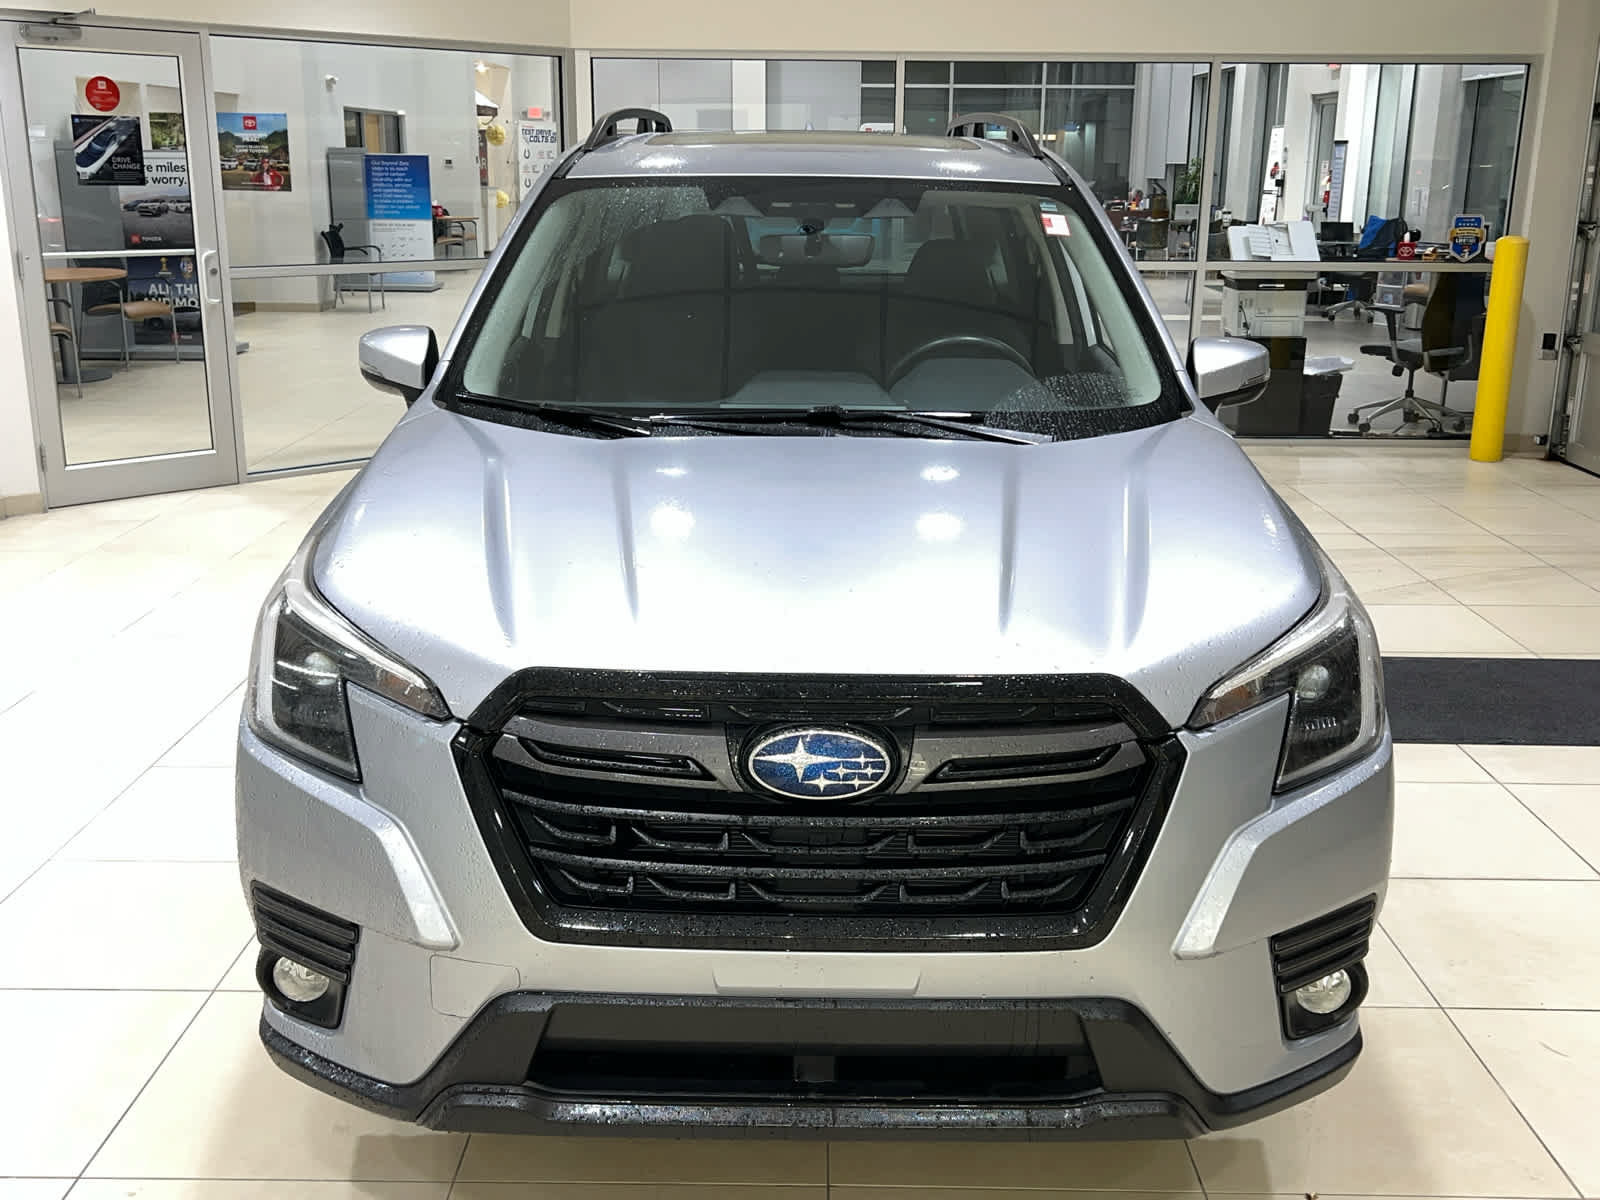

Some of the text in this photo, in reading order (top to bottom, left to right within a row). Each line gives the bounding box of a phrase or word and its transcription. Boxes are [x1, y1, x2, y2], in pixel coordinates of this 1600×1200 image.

[529, 135, 549, 143] COLTS
[156, 161, 186, 173] miles
[151, 176, 187, 187] worry.
